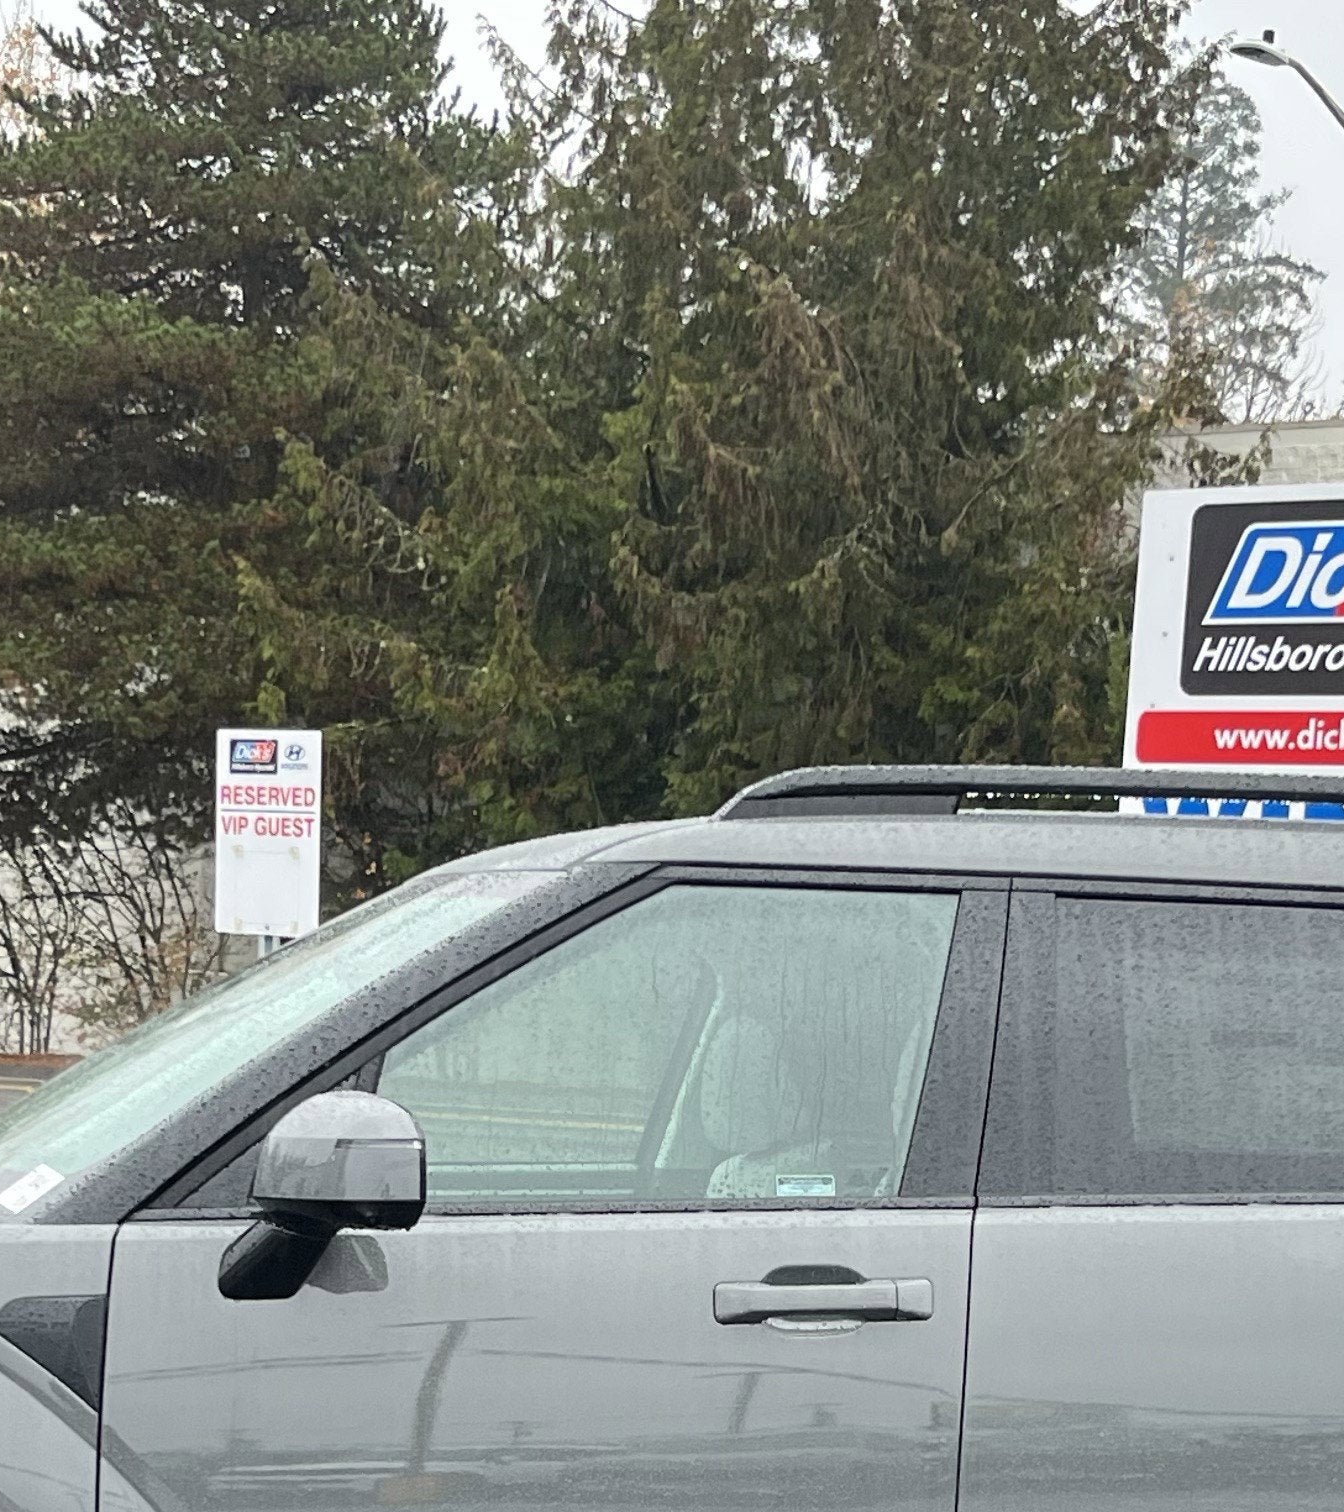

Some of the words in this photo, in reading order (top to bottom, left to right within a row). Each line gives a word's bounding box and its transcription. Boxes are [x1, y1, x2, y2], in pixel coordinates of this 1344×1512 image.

[220, 784, 316, 808] RESERVED
[221, 815, 249, 835] VIP
[254, 816, 316, 838] GUEST
